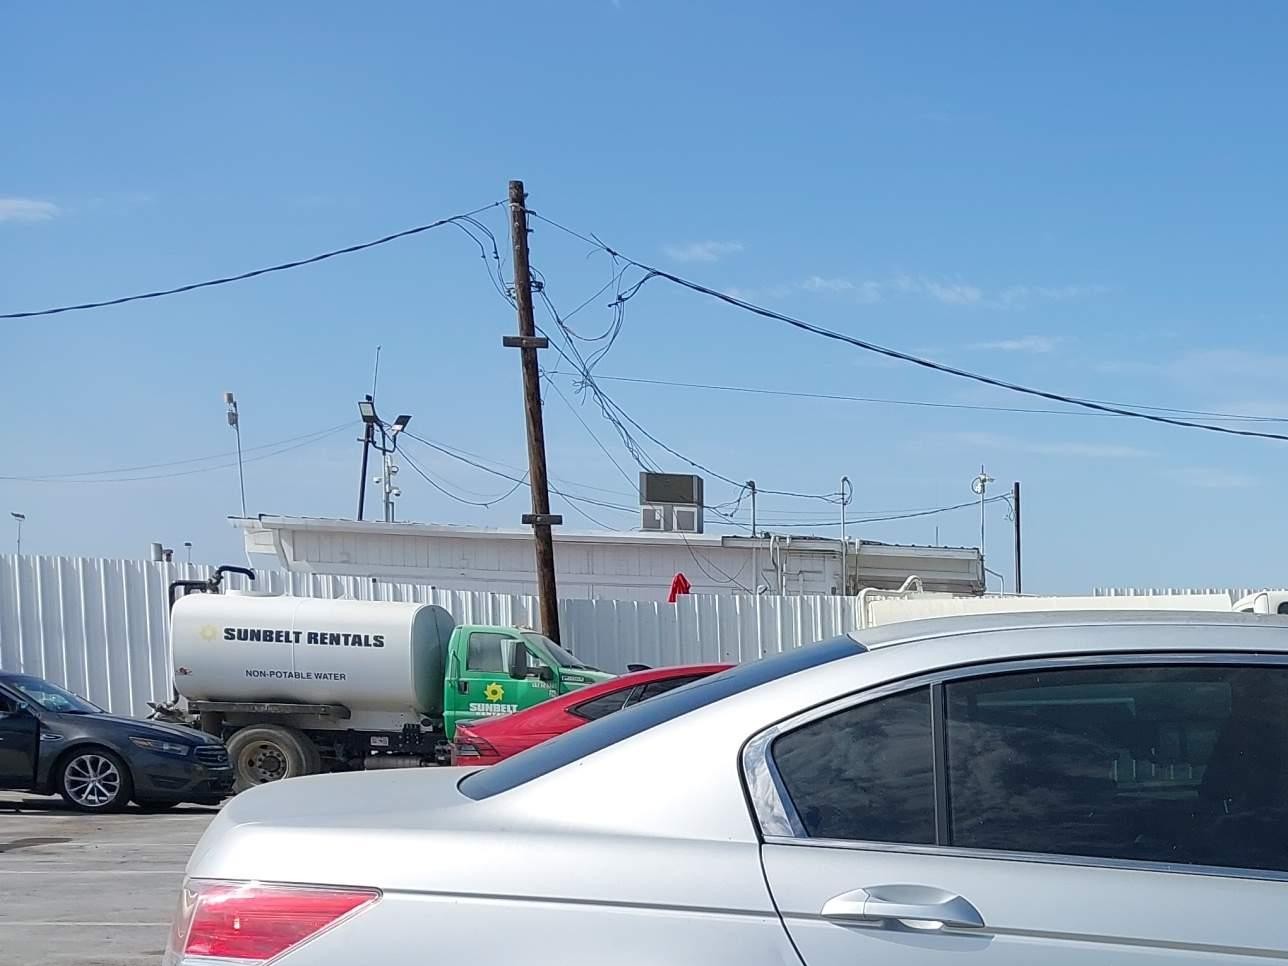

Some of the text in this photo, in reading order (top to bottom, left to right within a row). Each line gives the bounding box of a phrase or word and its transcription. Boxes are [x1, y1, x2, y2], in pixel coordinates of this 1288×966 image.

[223, 627, 385, 648] SUNBELT RENTALS
[245, 670, 346, 681] NON-POTABLE WATER
[469, 702, 519, 713] SUNBELT
